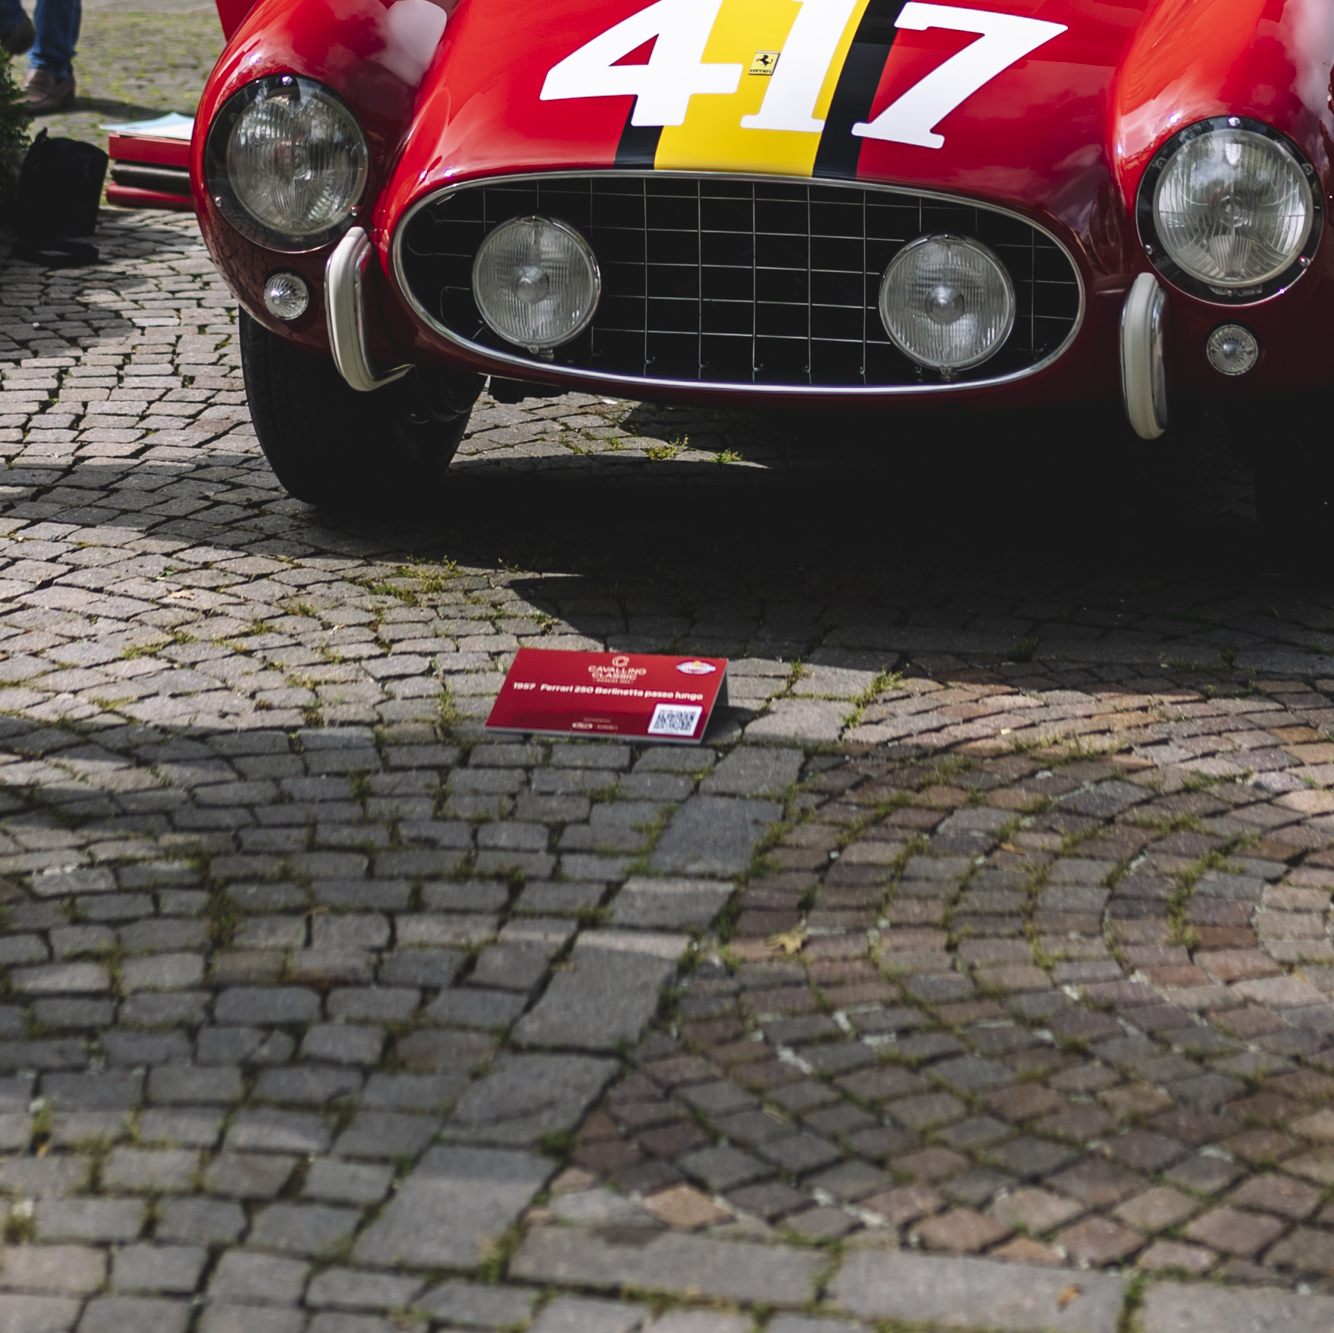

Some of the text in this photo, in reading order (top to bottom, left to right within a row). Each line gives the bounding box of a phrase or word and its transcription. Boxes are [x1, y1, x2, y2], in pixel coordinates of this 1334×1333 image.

[588, 665, 647, 676] CAVALLINO
[592, 672, 637, 681] CLASSIC
[513, 682, 704, 701] 1957 Ferrari 250 Berlinetta passo lungo
